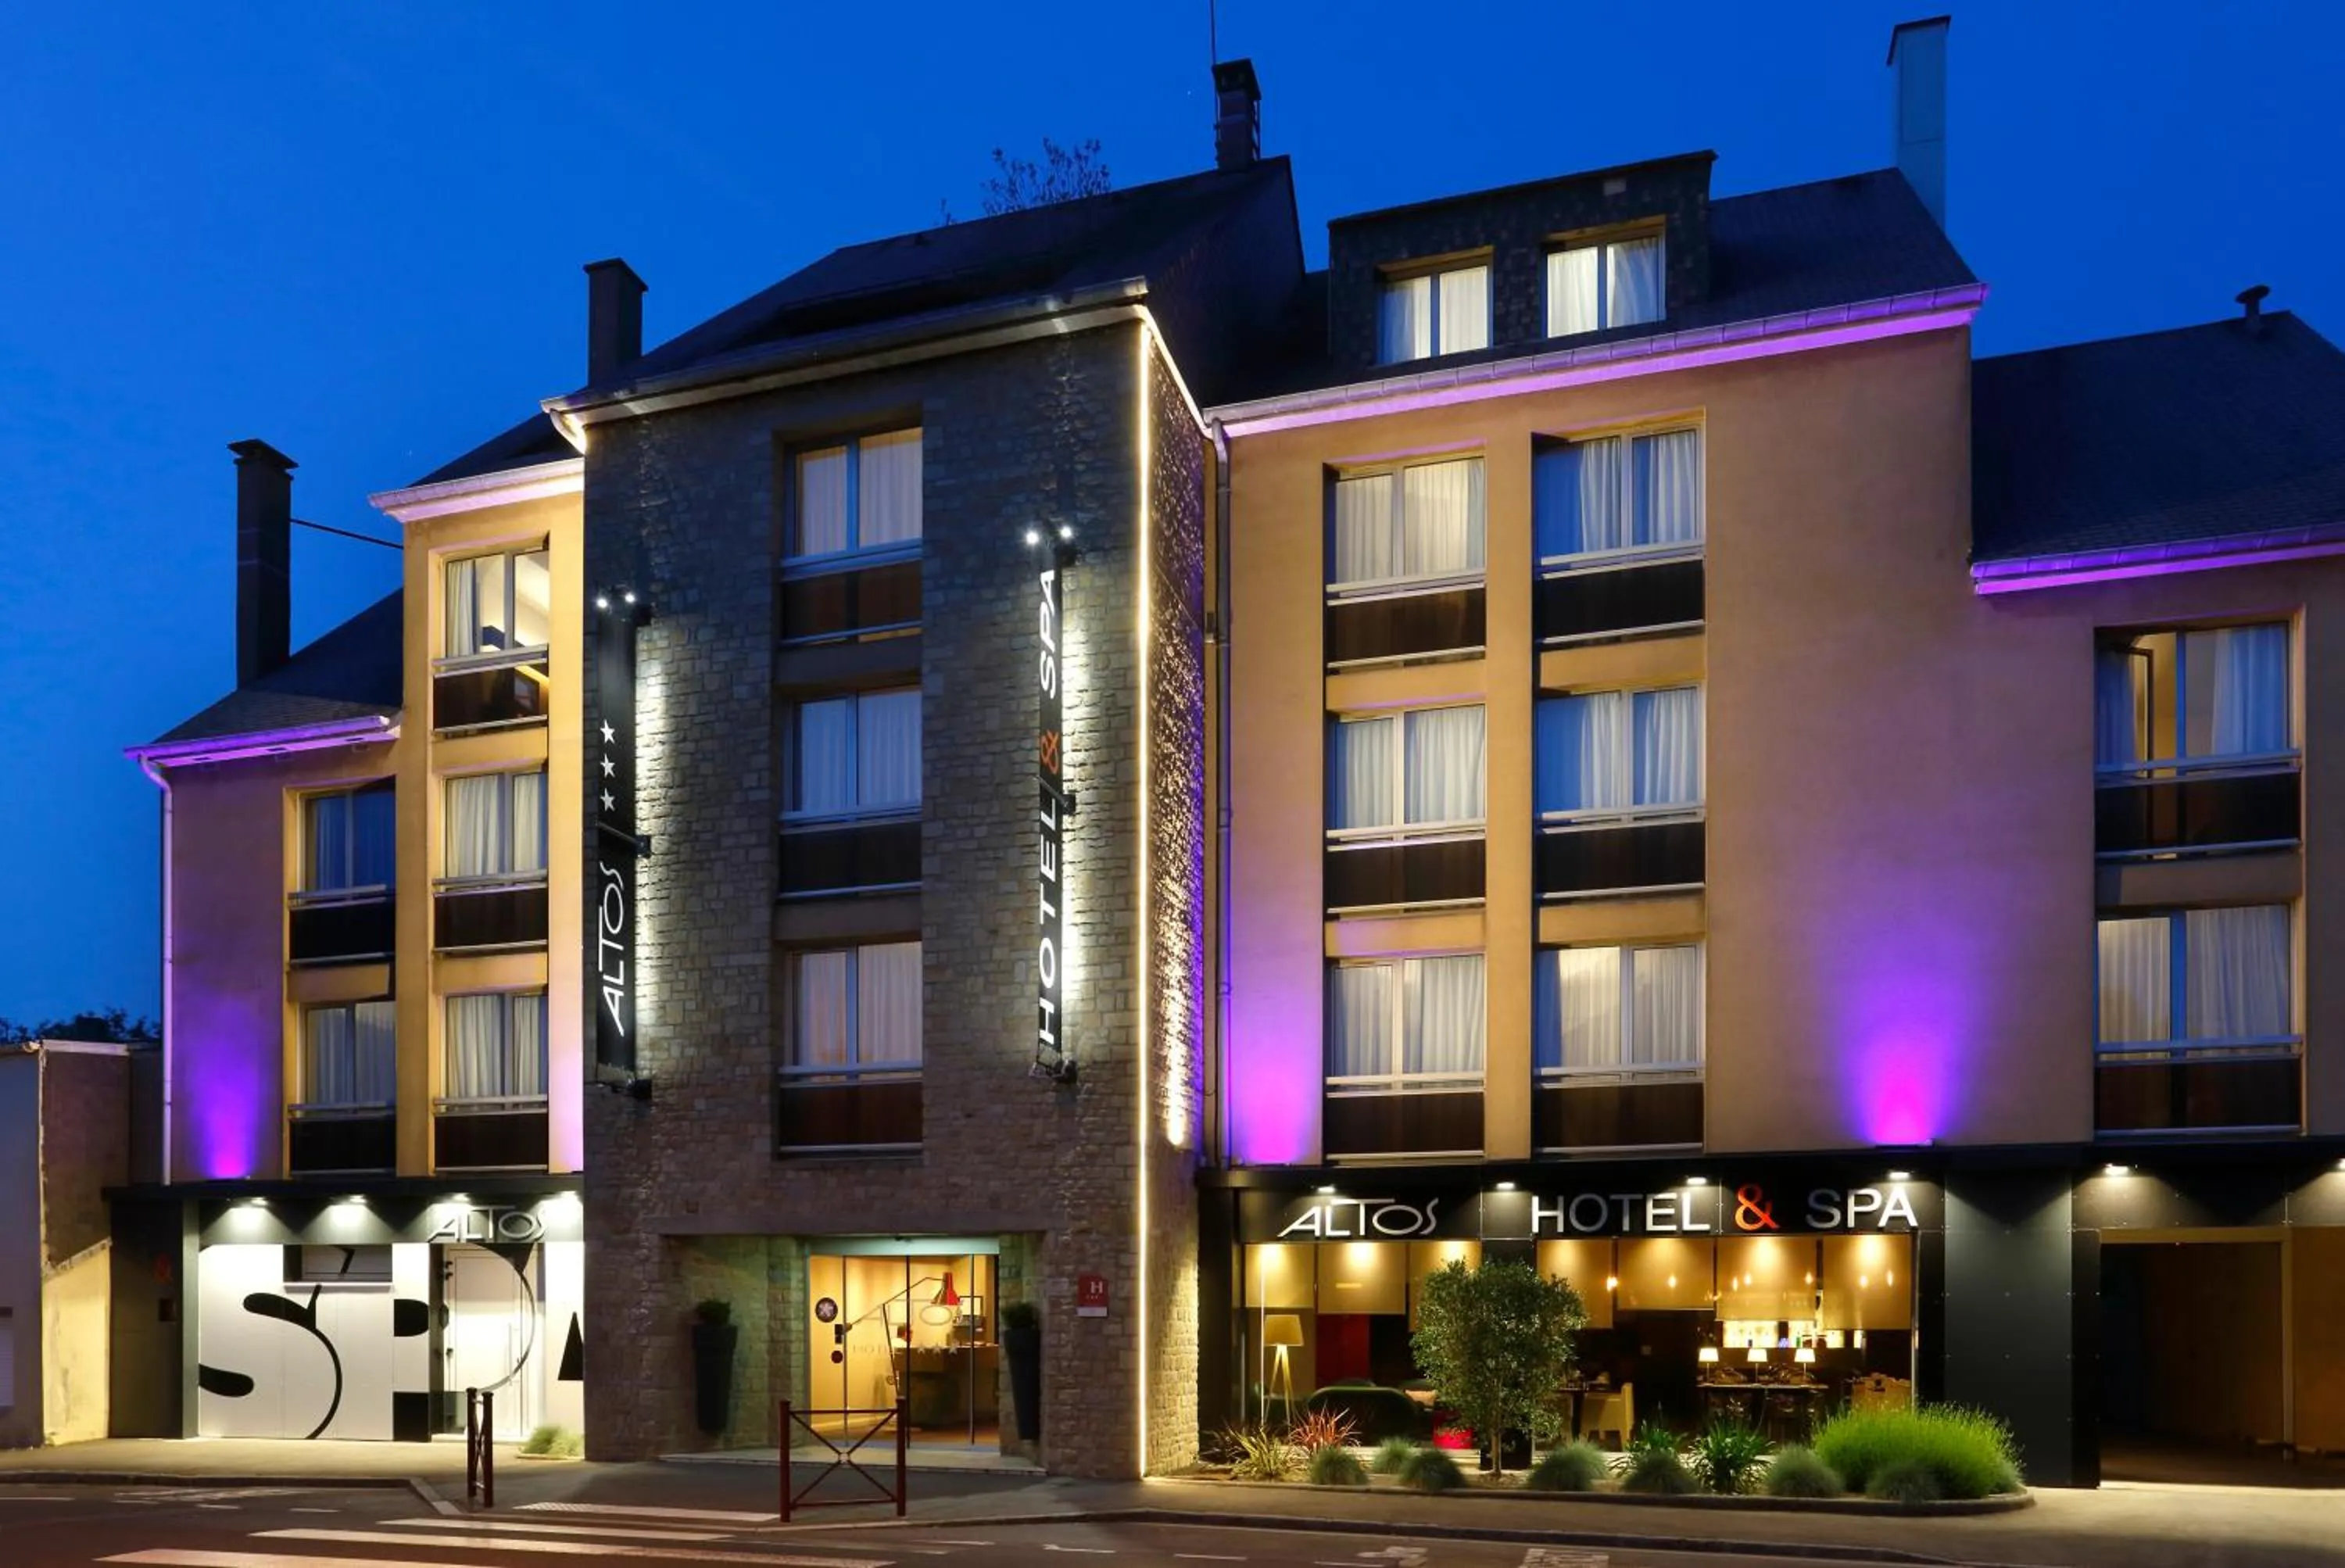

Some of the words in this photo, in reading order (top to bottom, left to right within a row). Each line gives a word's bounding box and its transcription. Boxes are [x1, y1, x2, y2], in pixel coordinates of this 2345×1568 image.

[1040, 569, 1056, 698] SPA
[1040, 731, 1059, 774] &
[1040, 798, 1056, 1044] HOTEL
[600, 862, 625, 1036] ALTOS
[427, 1205, 549, 1243] ALTOS
[1277, 1197, 1440, 1237] ALTOS
[1531, 1192, 1711, 1233] HOTEL
[1735, 1183, 1780, 1232] &
[1806, 1187, 1919, 1230] SPA
[1090, 1281, 1103, 1294] H
